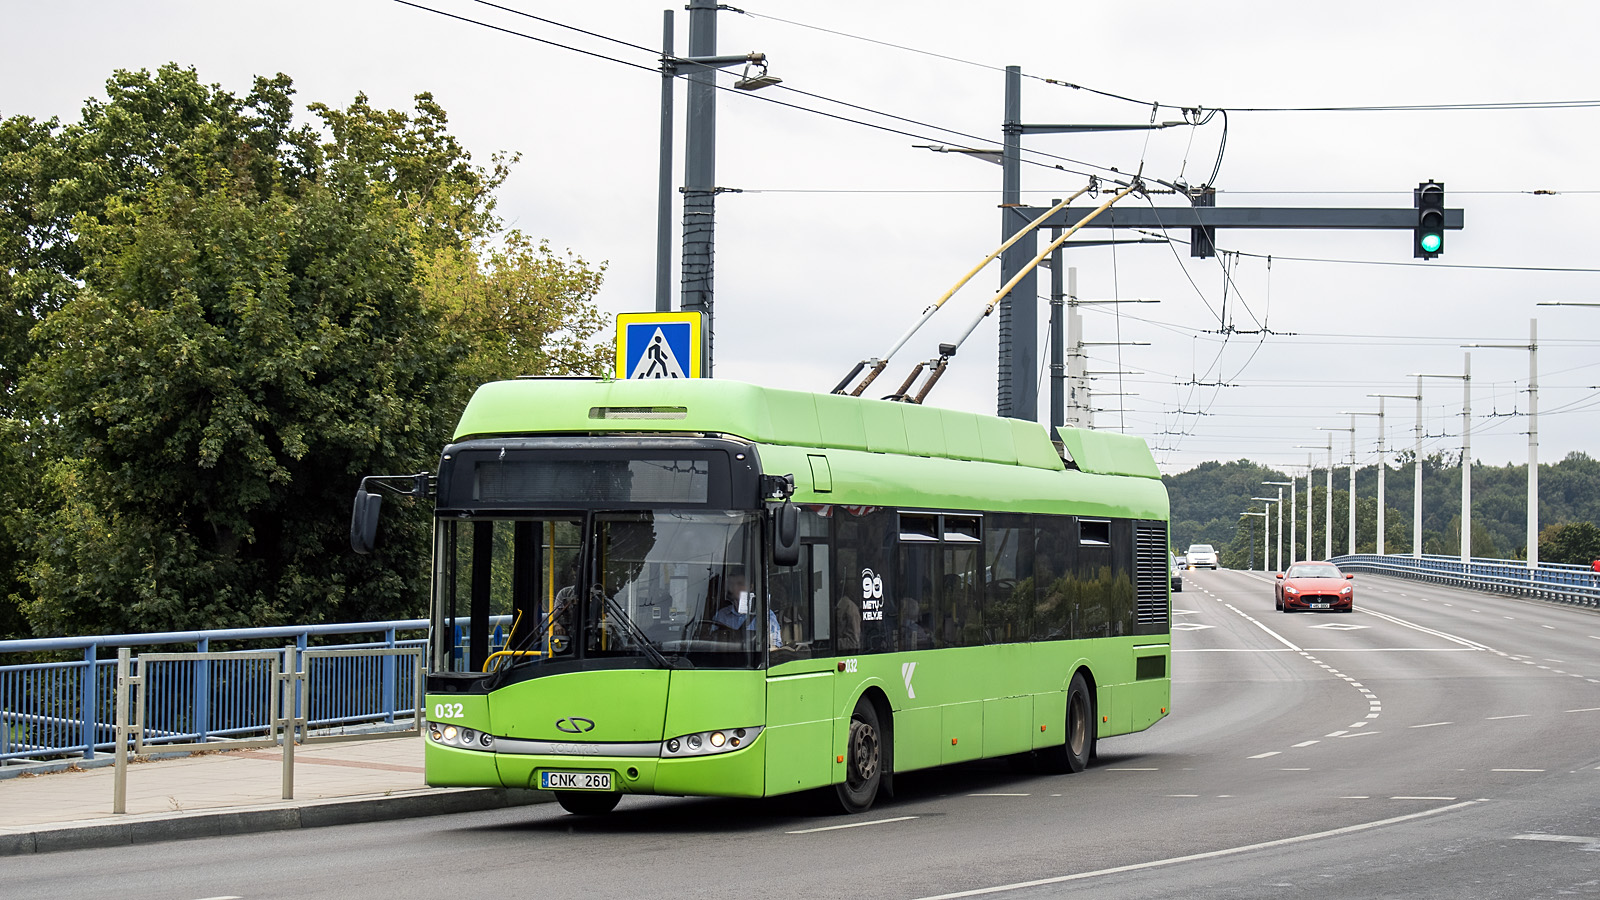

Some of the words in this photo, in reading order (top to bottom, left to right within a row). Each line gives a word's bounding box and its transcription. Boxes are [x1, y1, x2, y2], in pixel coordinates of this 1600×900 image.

[862, 577, 883, 599] 90
[845, 658, 858, 673] 032
[435, 703, 464, 718] 032
[549, 744, 600, 755] SOLARIS
[550, 774, 577, 787] CNK
[585, 775, 609, 787] 260
